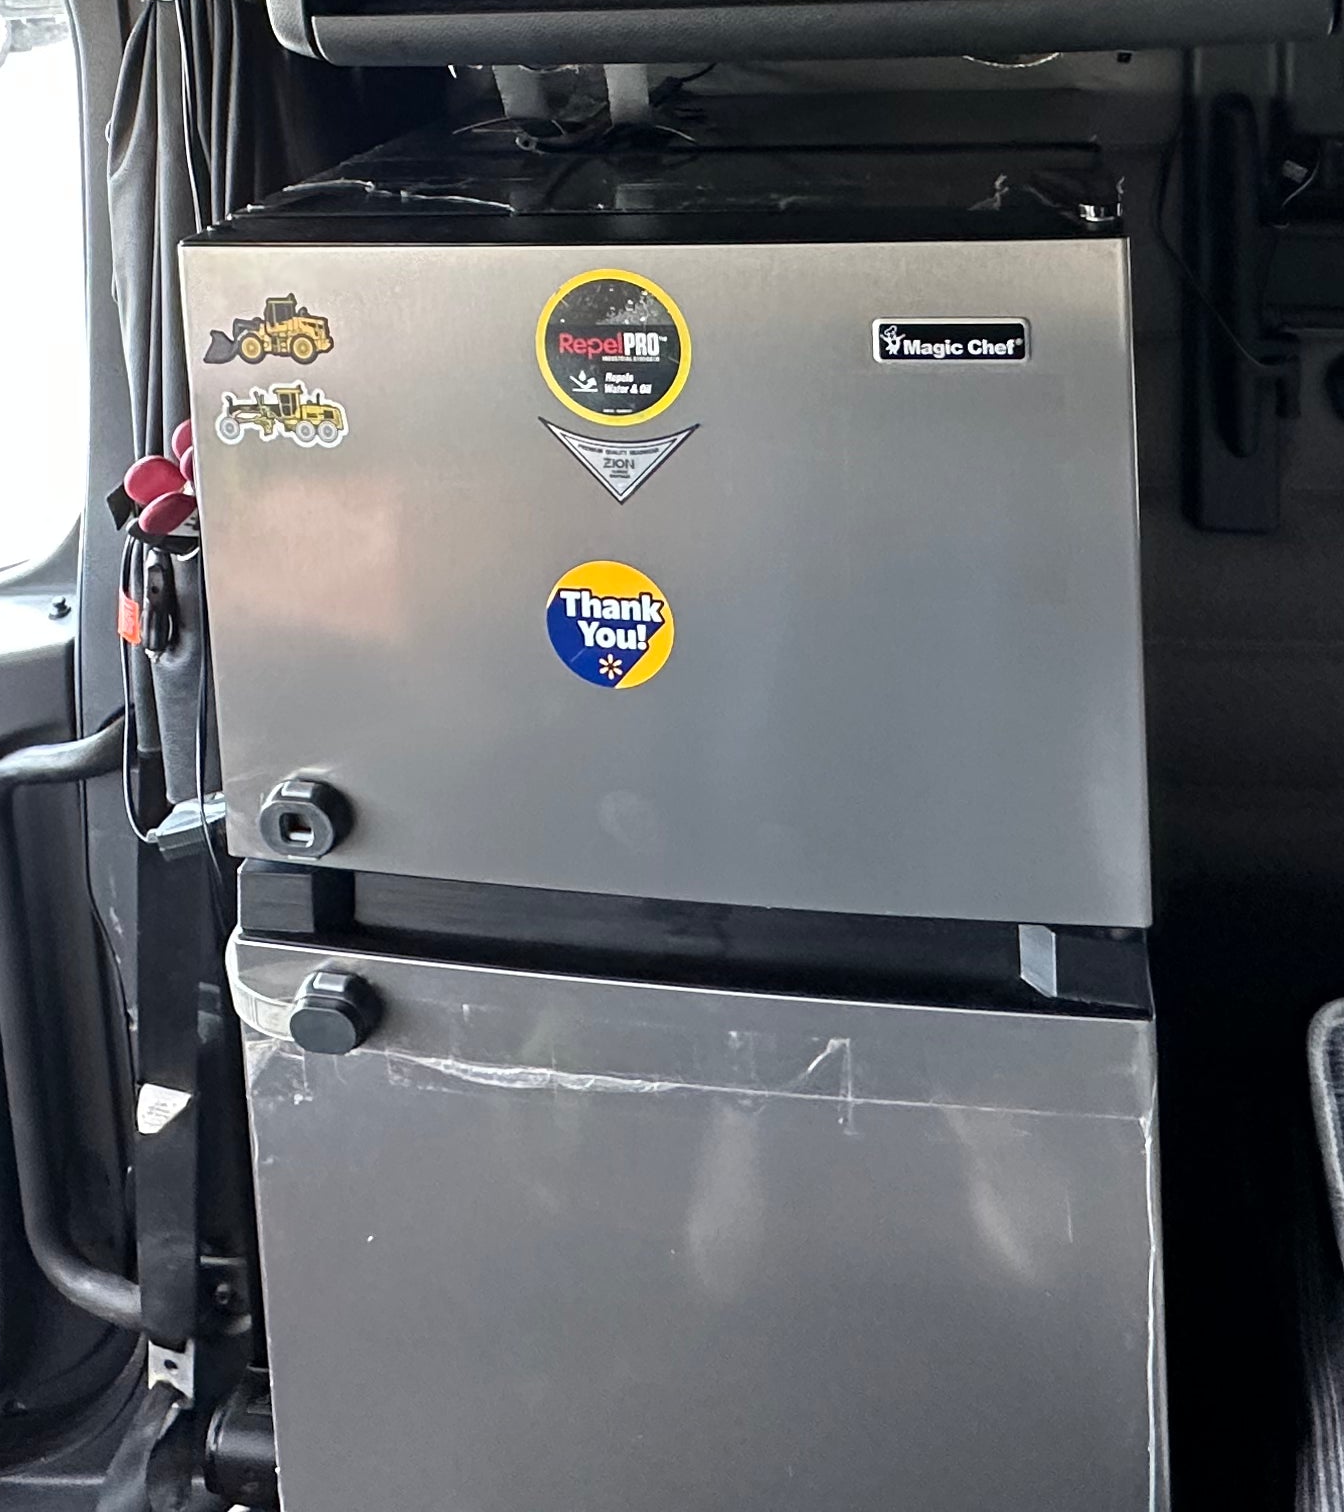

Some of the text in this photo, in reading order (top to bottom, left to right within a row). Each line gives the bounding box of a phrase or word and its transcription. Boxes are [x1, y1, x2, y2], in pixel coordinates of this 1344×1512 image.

[903, 338, 1015, 358] Magic Chef
[604, 384, 652, 394] Water & Oil
[602, 458, 636, 470] ZION
[560, 590, 664, 623] Thank
[577, 620, 648, 651] You!
